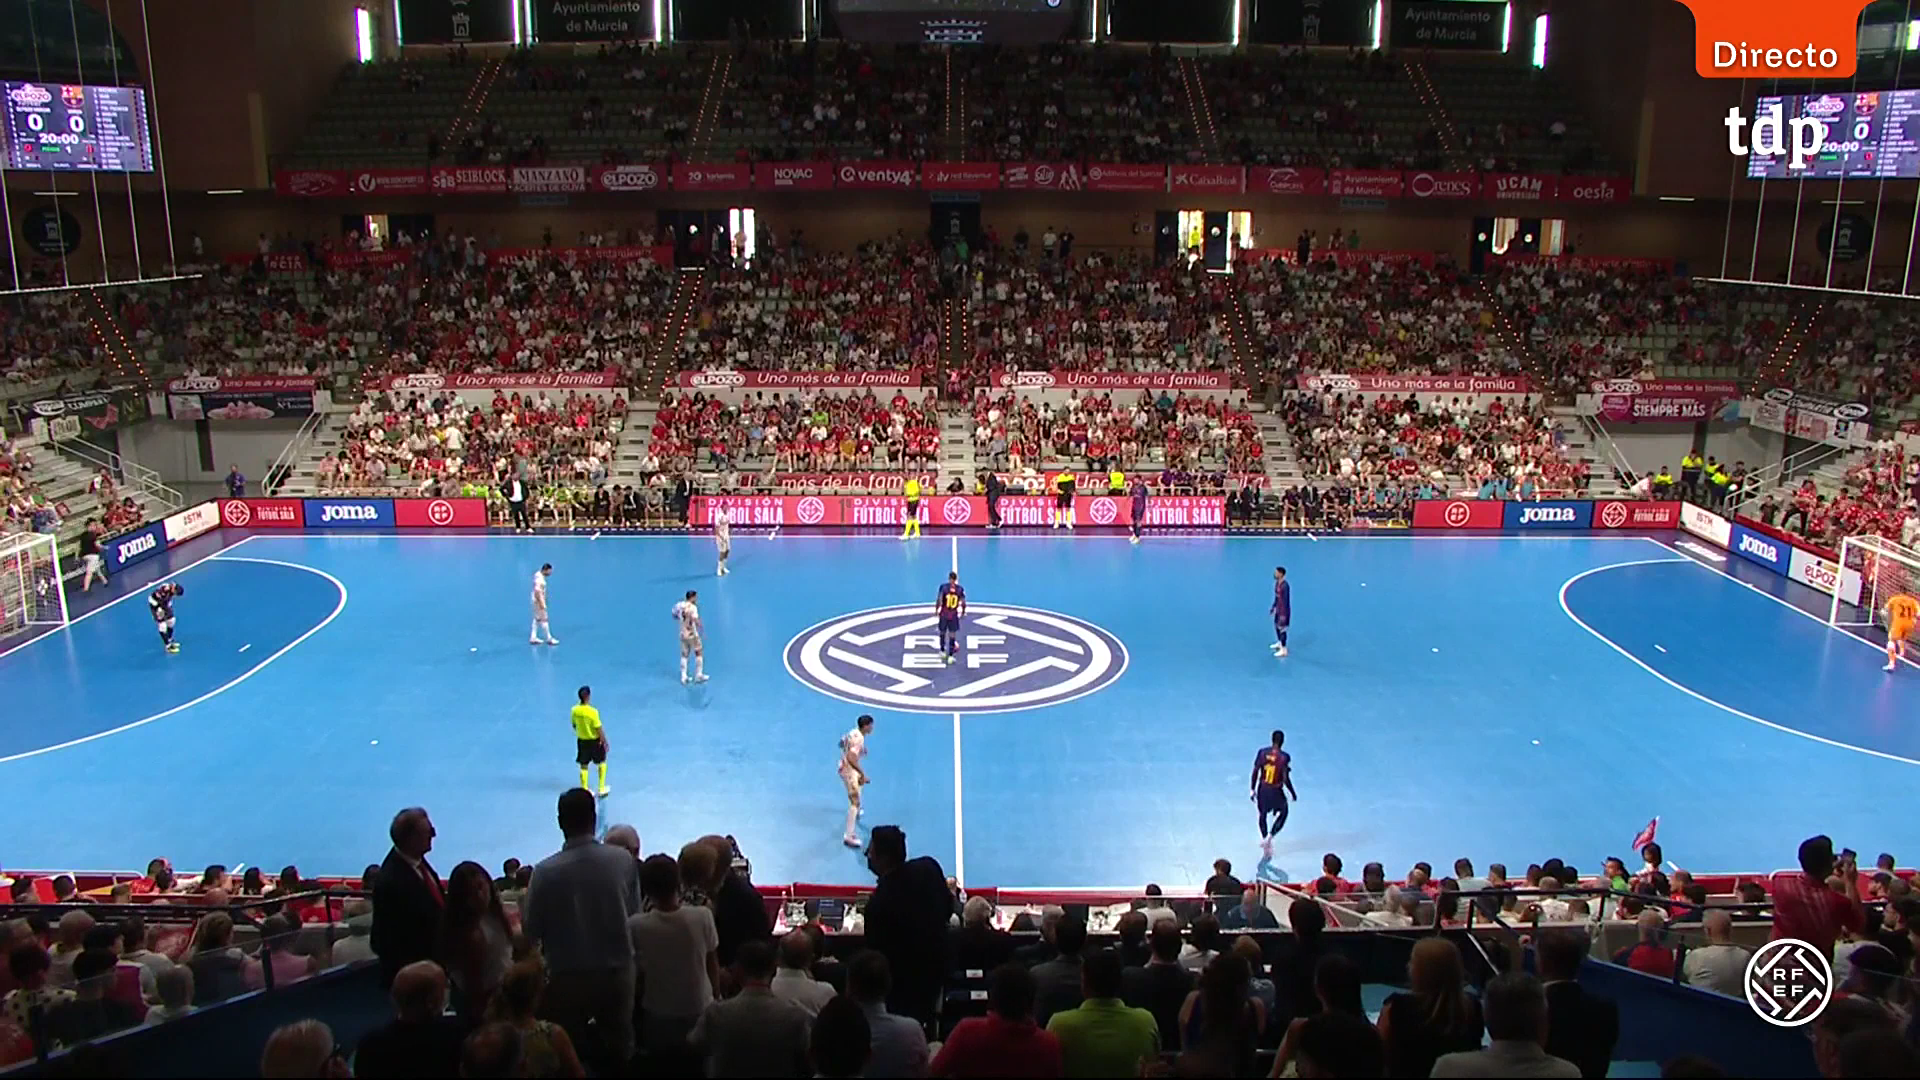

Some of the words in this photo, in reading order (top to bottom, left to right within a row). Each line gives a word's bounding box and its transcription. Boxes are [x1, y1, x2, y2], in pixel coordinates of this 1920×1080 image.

[553, 0, 640, 14] Ayuntamiento
[1405, 7, 1491, 24] Ayuntamiento
[566, 20, 581, 32] de
[586, 19, 628, 32] Murcia
[1416, 27, 1431, 39] de
[1435, 28, 1476, 41] Murcia
[28, 113, 43, 131] 0
[69, 115, 84, 132] 0
[1854, 123, 1869, 139] 0
[39, 133, 79, 144] 20:00
[1821, 141, 1859, 152] 20:00
[456, 169, 506, 183] SEIBLOCK
[519, 169, 579, 182] MANZANO
[774, 168, 813, 179] NOVAC
[1189, 174, 1237, 185] CaixaBank
[1344, 174, 1398, 184] Ayuntamiento
[1356, 186, 1383, 195] Murcia
[1497, 176, 1543, 192] UCAM
[456, 375, 486, 386] Uno
[490, 375, 515, 385] más
[520, 374, 536, 385] de
[539, 374, 551, 385] la
[552, 372, 604, 387] familia
[757, 373, 788, 384] Uno
[792, 373, 818, 384] más
[824, 373, 840, 384] de
[843, 373, 855, 384] la
[857, 371, 910, 386] familia
[1067, 373, 1097, 385] Uno
[1102, 373, 1128, 385] más
[1133, 374, 1149, 385] de
[1153, 374, 1165, 385] la
[1168, 374, 1218, 388] familia
[1371, 377, 1400, 389] Uno
[1405, 378, 1431, 389] más
[1435, 379, 1450, 389] de
[1454, 379, 1465, 389] la
[1469, 378, 1515, 391] familia
[1645, 383, 1664, 392] Uno
[1632, 404, 1679, 417] SIEMPRE
[1681, 400, 1706, 417] MÁS
[782, 476, 815, 490] más
[822, 475, 842, 489] de
[848, 475, 862, 489] la
[708, 497, 783, 506] DIVISIÓN
[853, 498, 929, 506] DIVISIN
[1146, 497, 1220, 506] DIVISIÓN
[754, 506, 783, 524] SALA
[853, 504, 897, 524] FÚTBOL
[1000, 504, 1044, 525] FÚTBOL
[1146, 504, 1190, 525] FÚTBOL
[1192, 507, 1221, 525] SALA
[945, 593, 958, 609] 10
[1899, 603, 1912, 618] 21
[1264, 763, 1275, 784] 11
